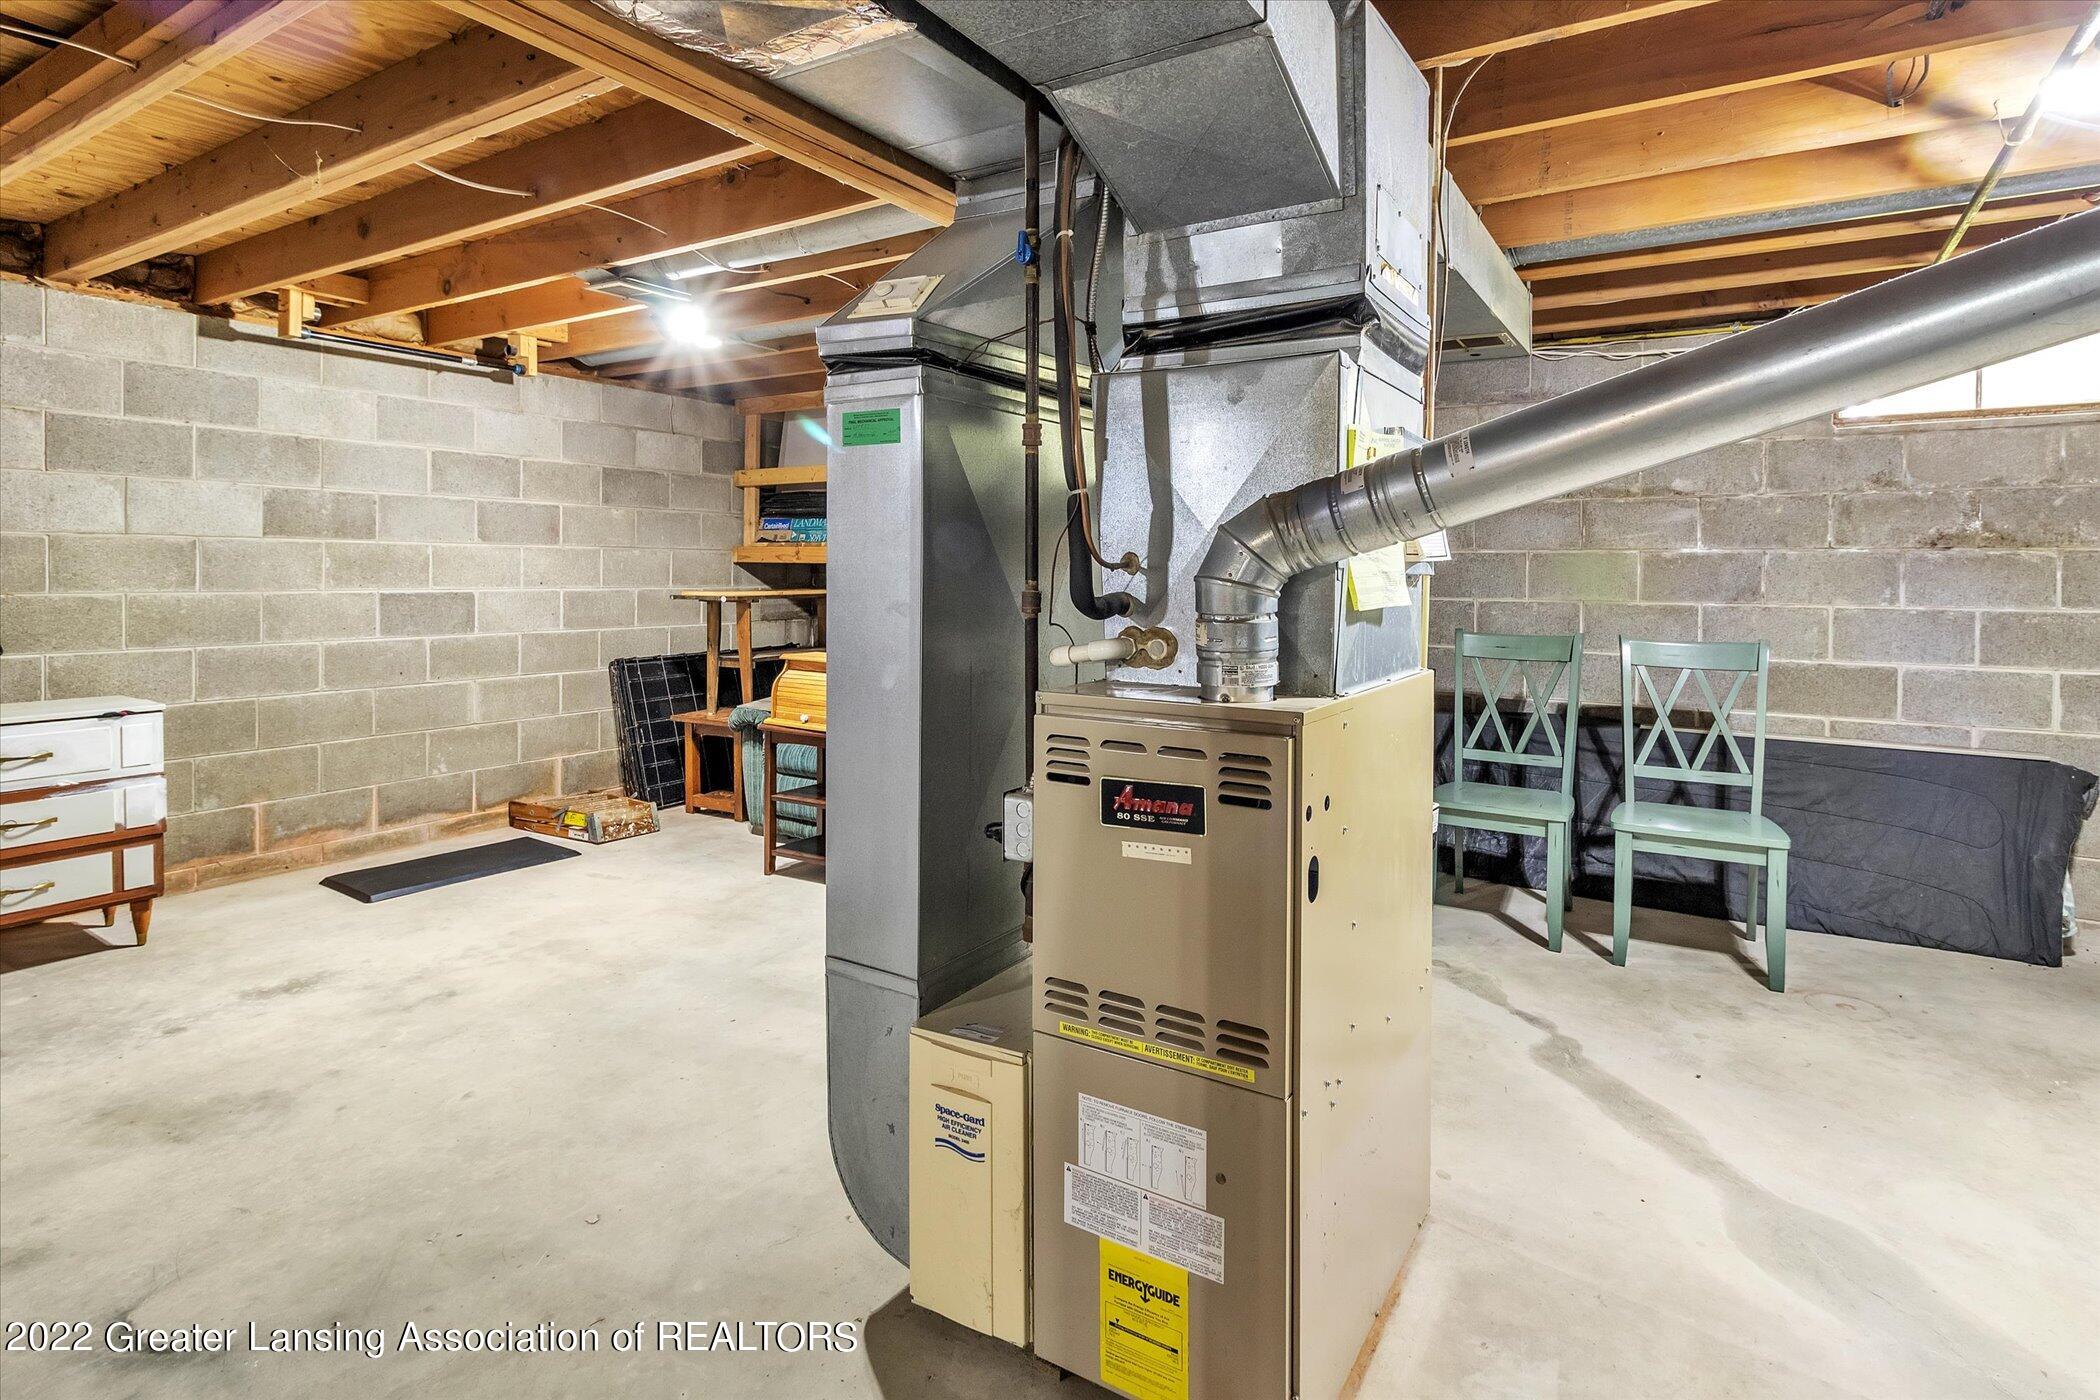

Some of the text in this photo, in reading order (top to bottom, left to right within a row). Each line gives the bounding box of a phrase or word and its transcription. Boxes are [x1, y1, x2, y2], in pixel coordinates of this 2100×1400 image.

[1114, 785, 1194, 815] Amana
[1116, 812, 1155, 822] 80 SSE
[1062, 1023, 1090, 1037] WARNING:
[1144, 1045, 1195, 1064] AVERTISSEMENT:
[935, 1103, 985, 1127] Space-Gard
[937, 1115, 982, 1134] HIGH EFFICIENCY
[952, 1127, 977, 1139] CLEANER
[1108, 1268, 1180, 1308] ENERGYGUIDE
